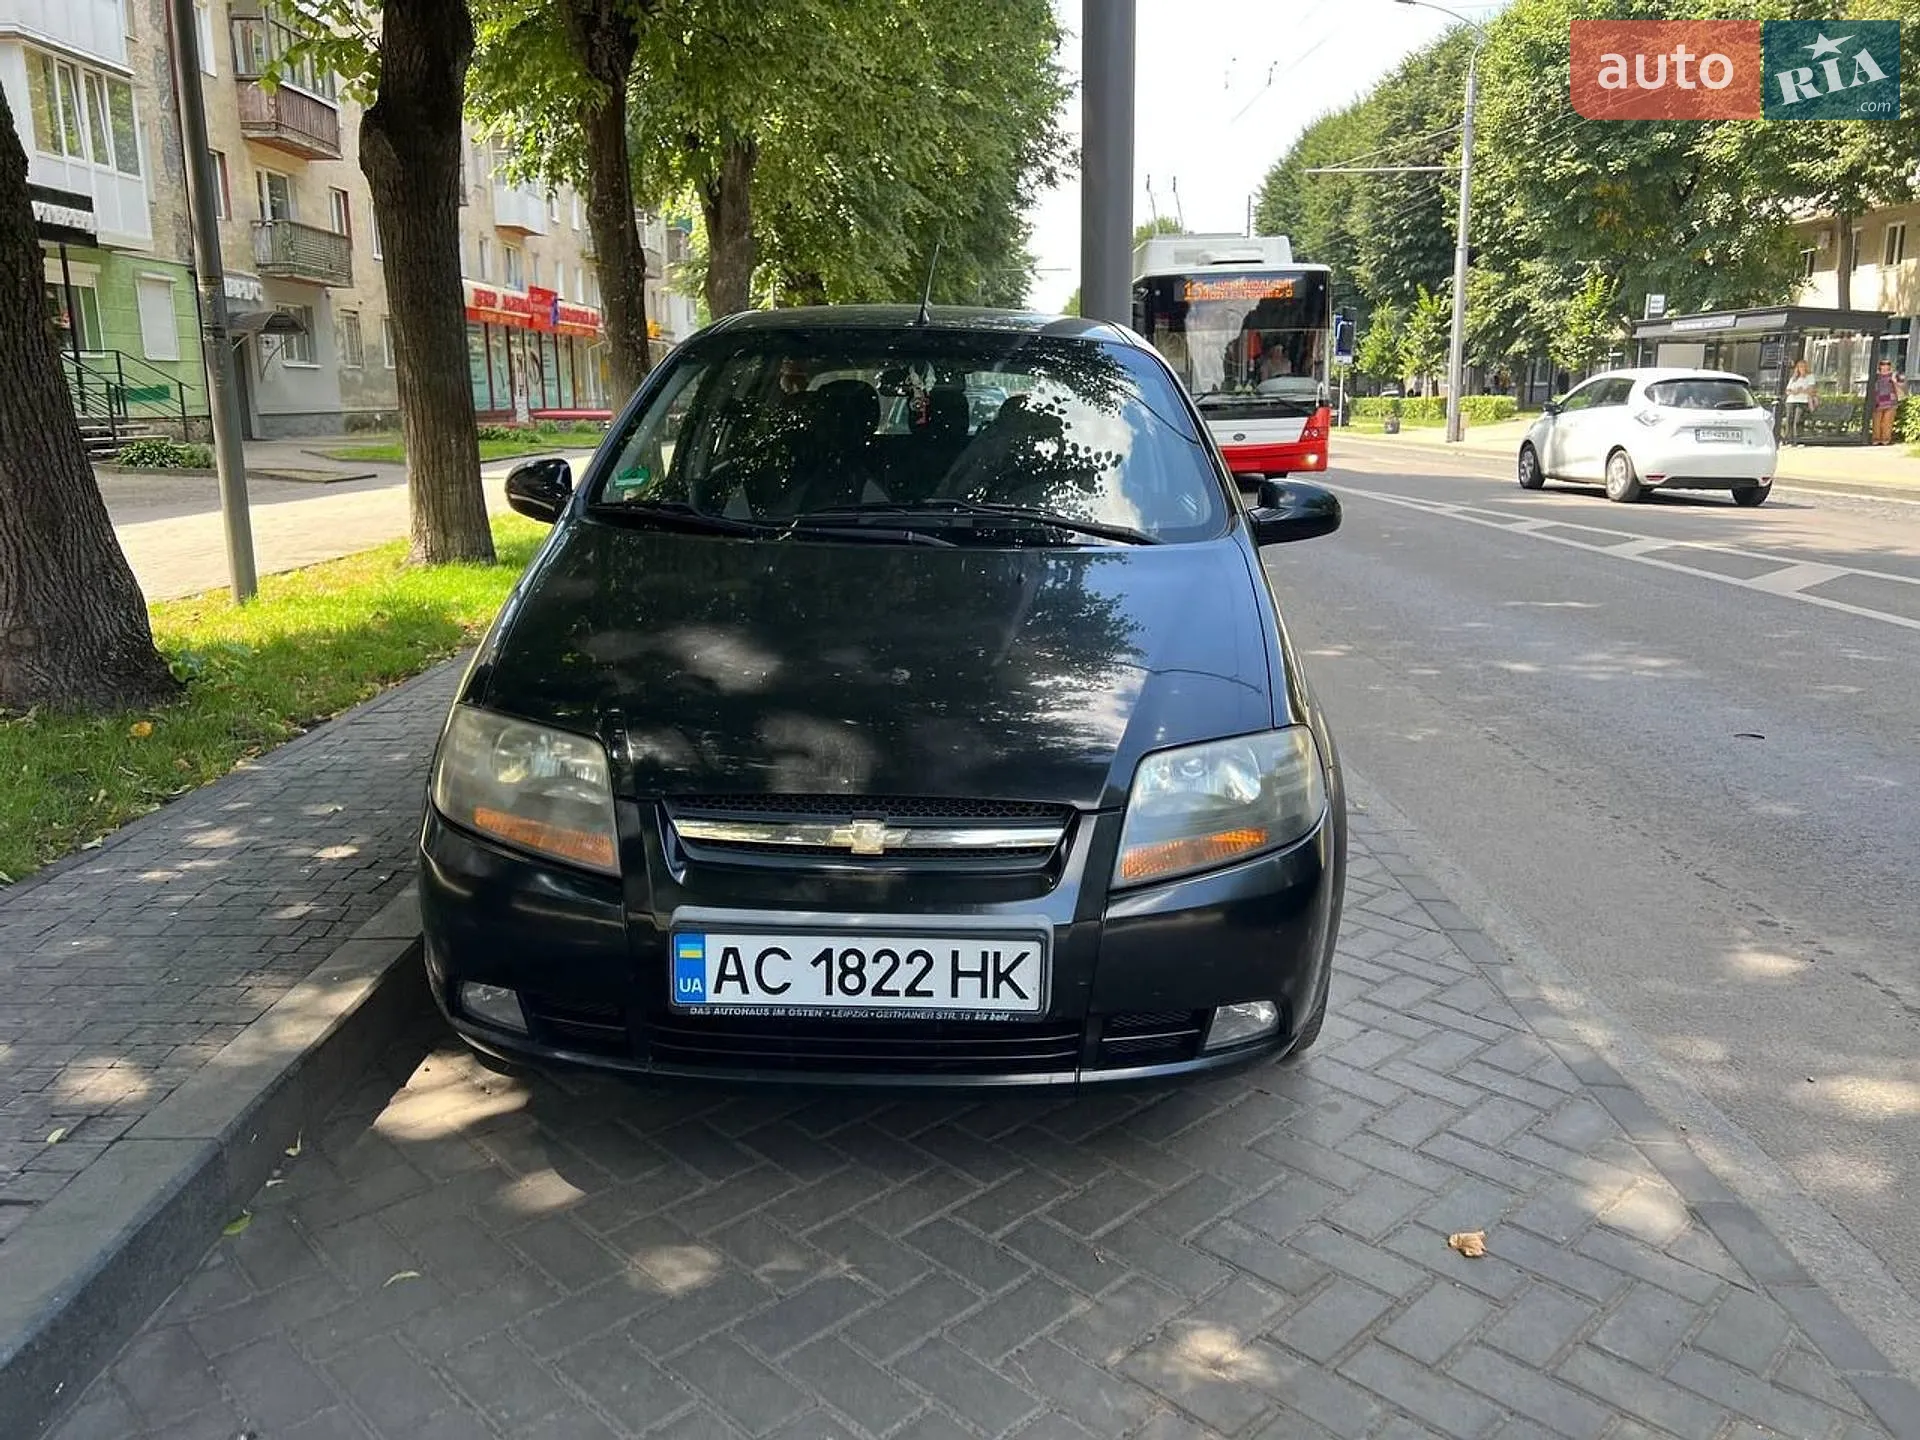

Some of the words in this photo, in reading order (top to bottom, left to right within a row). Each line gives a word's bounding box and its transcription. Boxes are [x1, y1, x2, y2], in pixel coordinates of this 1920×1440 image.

[713, 947, 792, 995] AC
[810, 948, 934, 997] 1822
[951, 950, 1030, 1000] HK
[679, 977, 703, 993] UA
[714, 1008, 769, 1016] AUTOHAUS
[831, 1010, 869, 1018] LEIPZIG
